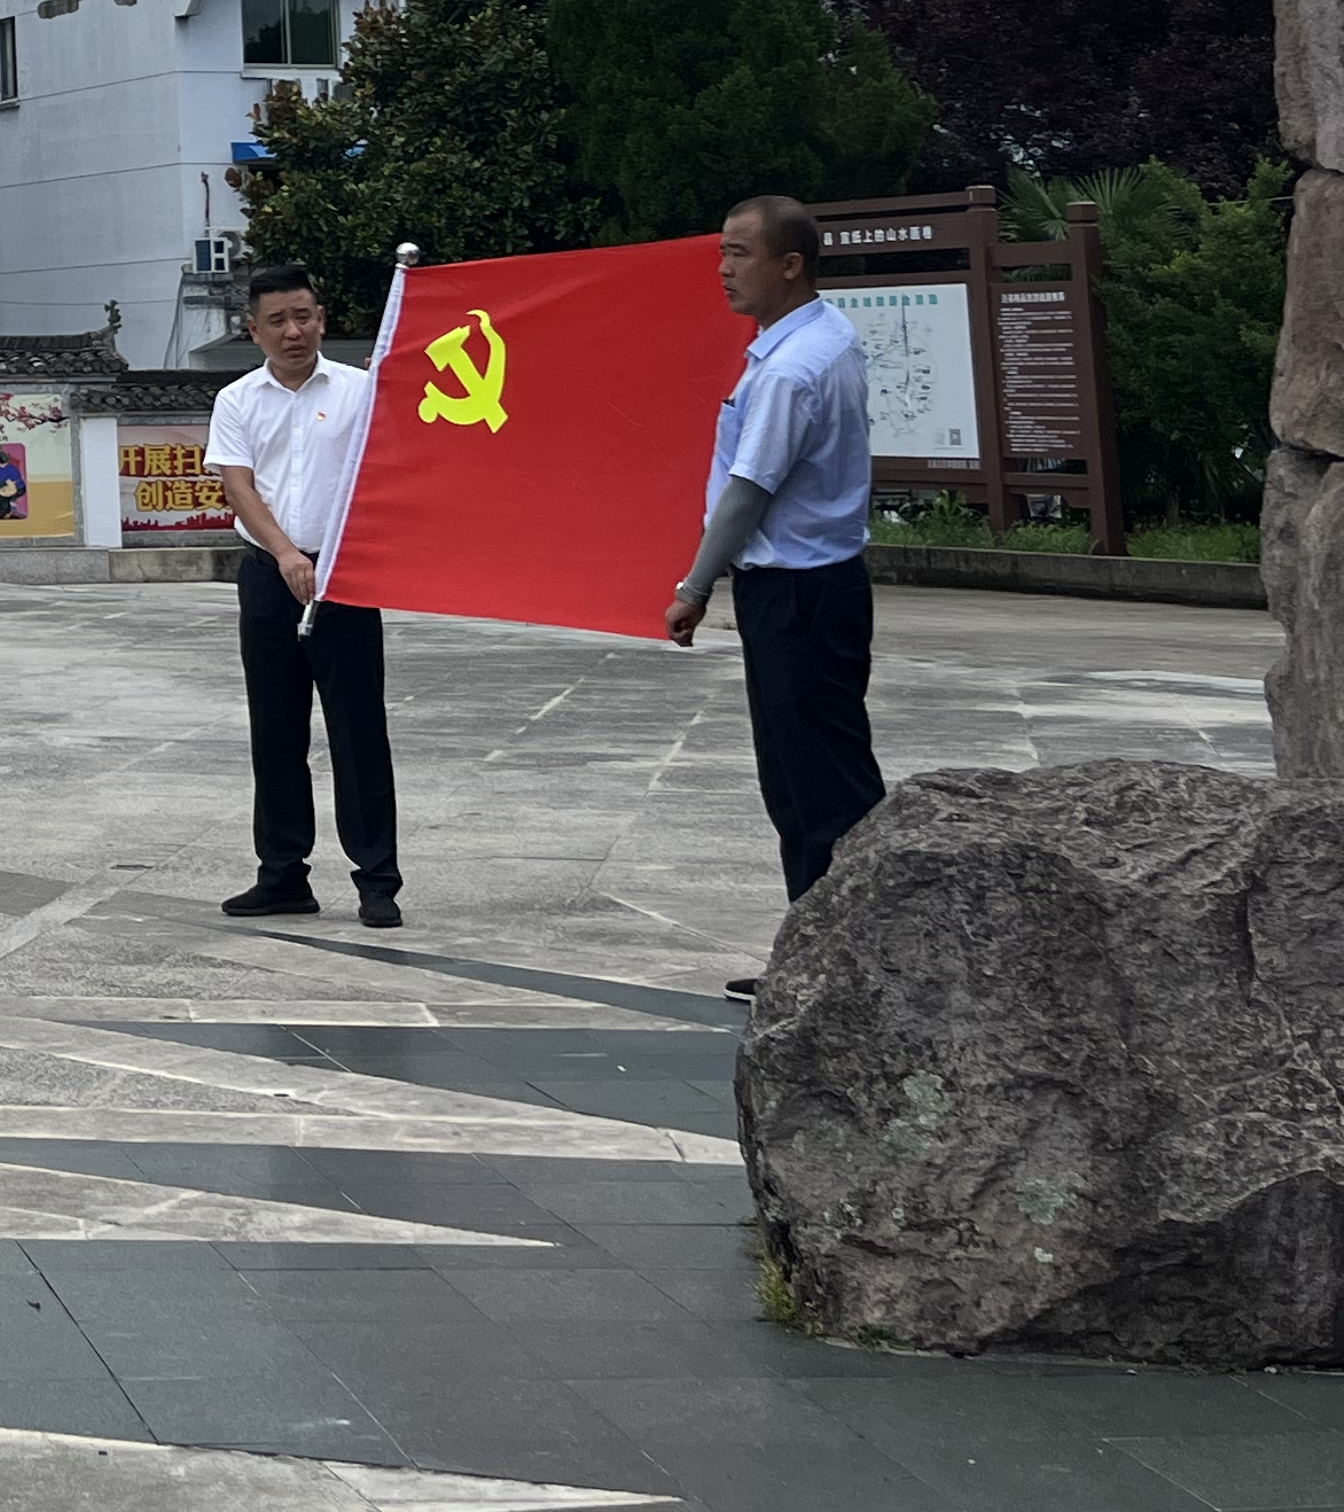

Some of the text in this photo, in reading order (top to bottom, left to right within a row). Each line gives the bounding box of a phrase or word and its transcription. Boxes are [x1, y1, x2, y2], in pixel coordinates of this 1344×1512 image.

[118, 443, 210, 476] 开展扫
[134, 479, 230, 511] 创造安
